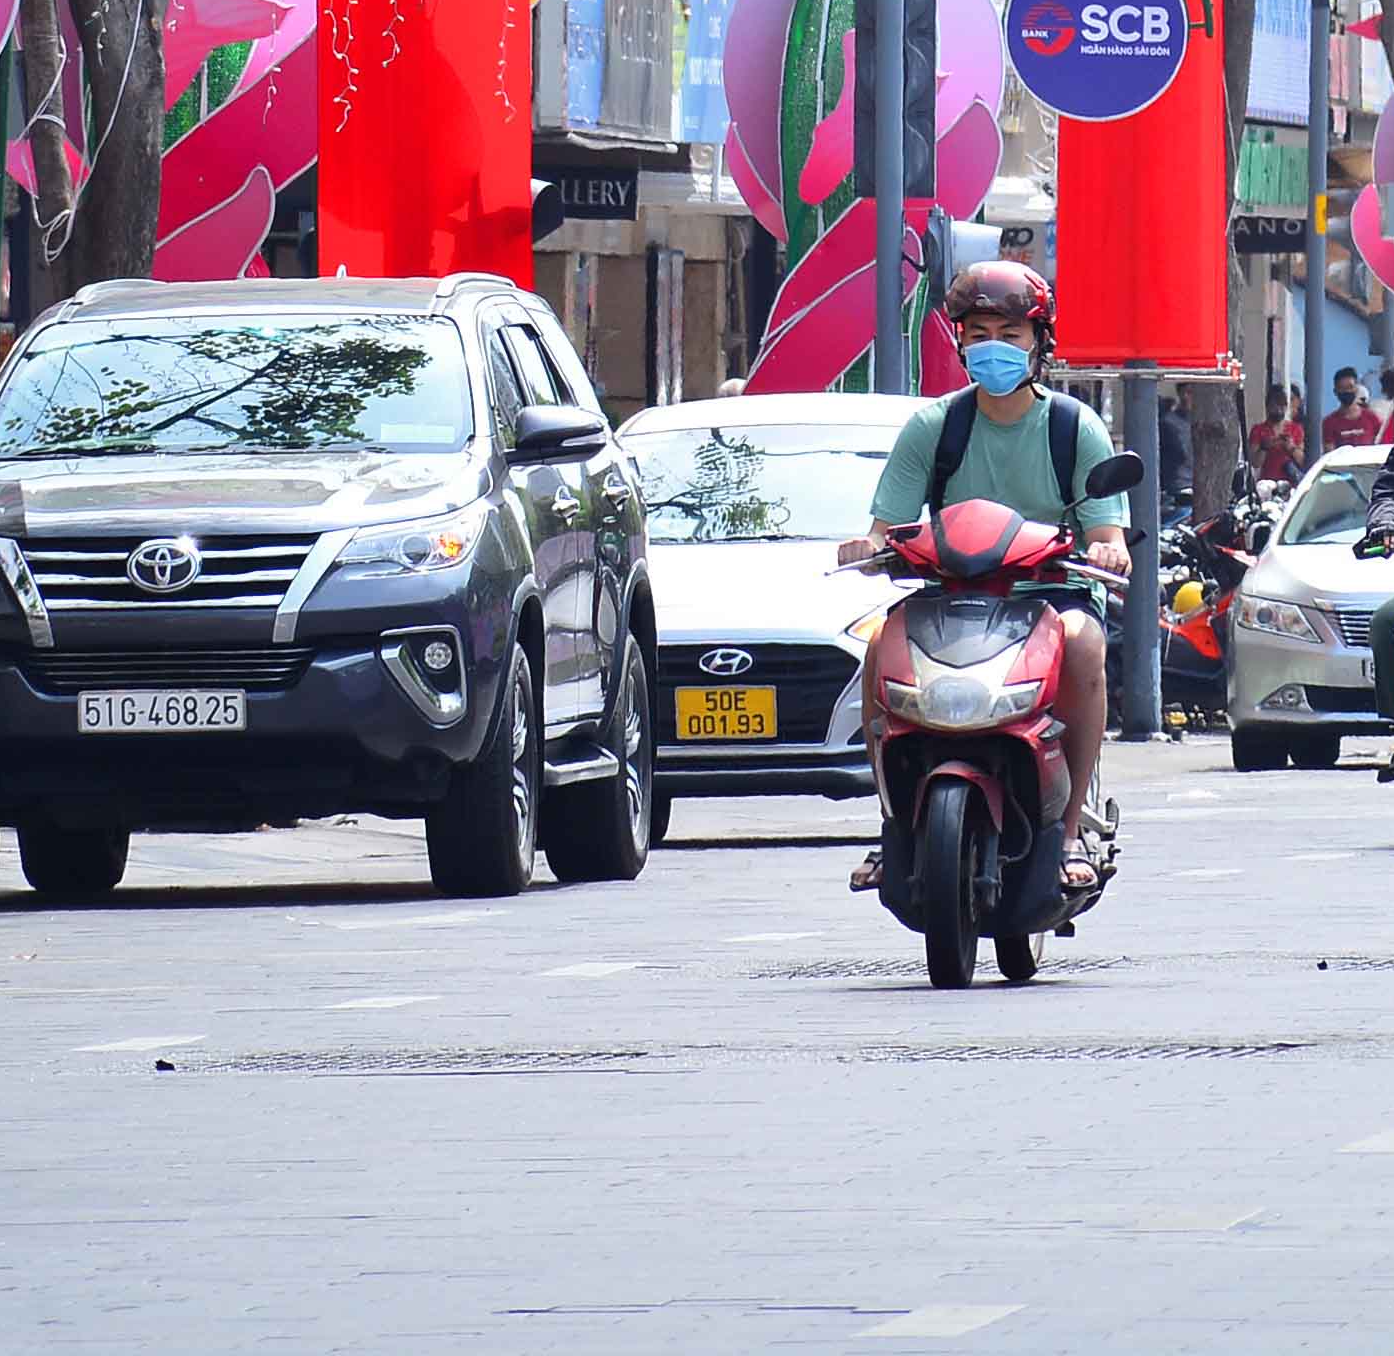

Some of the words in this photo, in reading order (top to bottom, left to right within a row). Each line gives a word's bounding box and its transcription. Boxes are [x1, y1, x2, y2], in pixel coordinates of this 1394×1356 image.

[1021, 29, 1049, 38] BANK
[1081, 4, 1170, 42] SCB
[85, 696, 239, 727] 51G-468.25
[705, 691, 747, 712] 50E
[688, 714, 765, 735] 001.93
